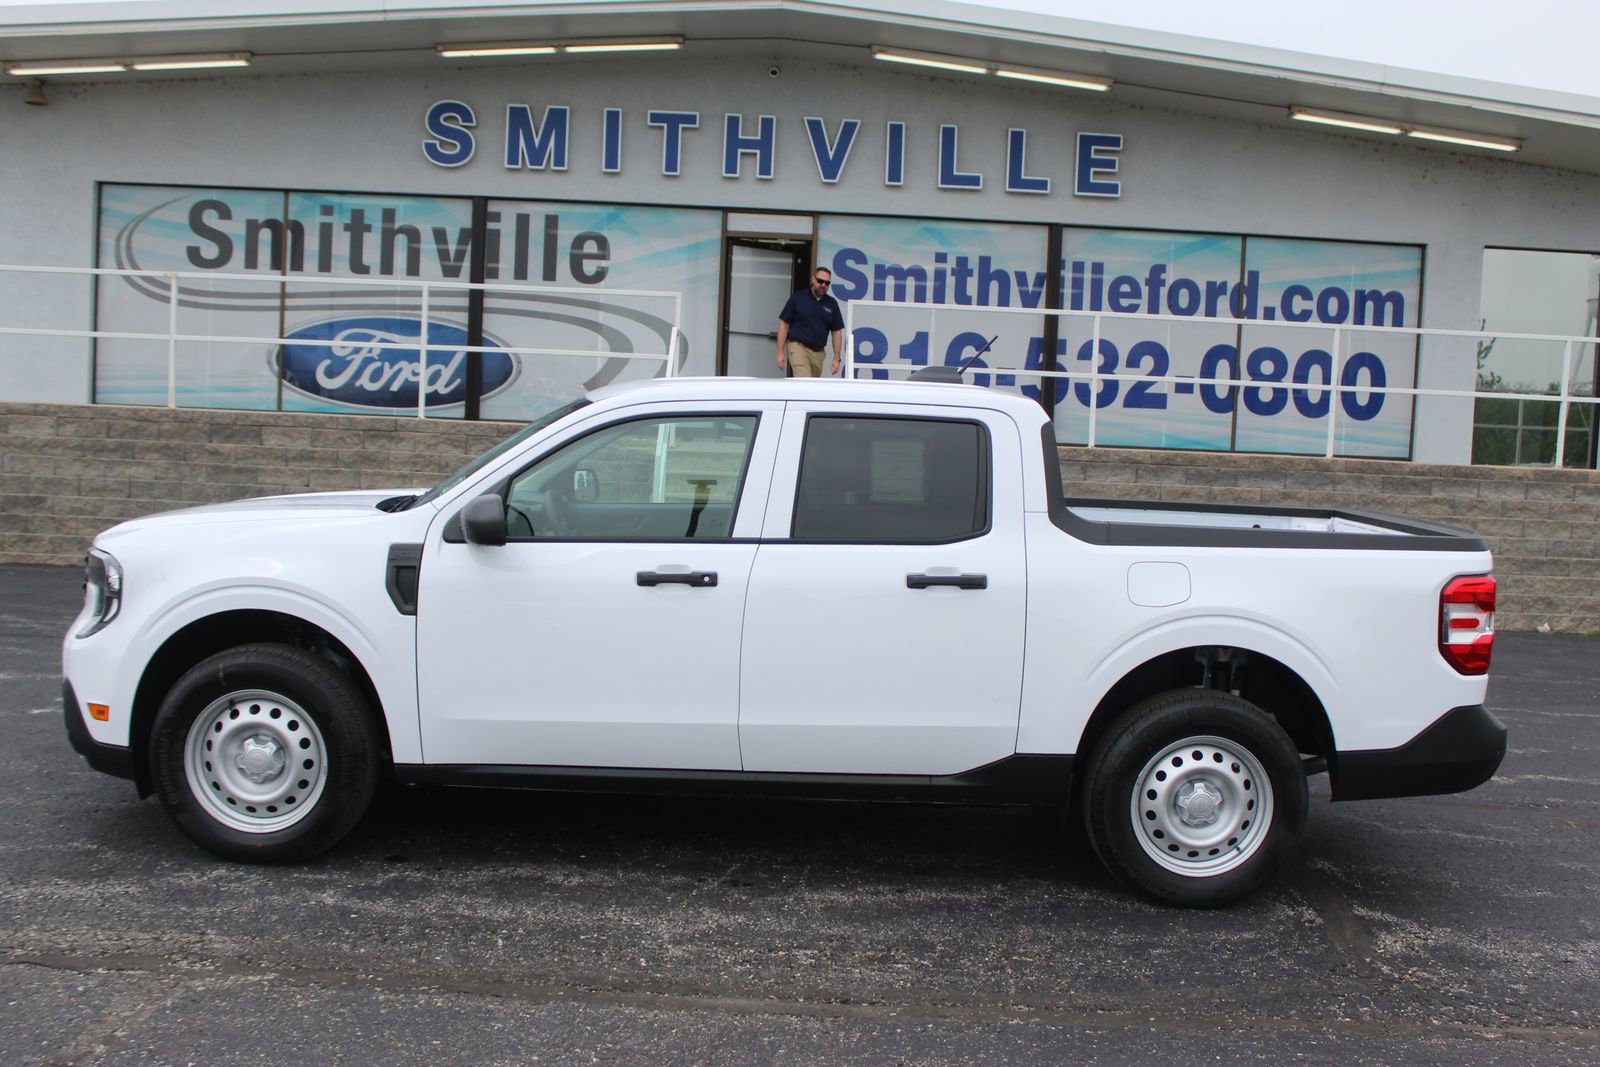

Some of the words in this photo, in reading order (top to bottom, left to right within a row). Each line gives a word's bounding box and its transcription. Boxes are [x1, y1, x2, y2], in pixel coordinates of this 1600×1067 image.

[422, 99, 1123, 197] SMITHVILLE
[186, 199, 611, 285] Smithville
[315, 328, 467, 395] Ford
[842, 326, 1387, 421] 816-532-0800
